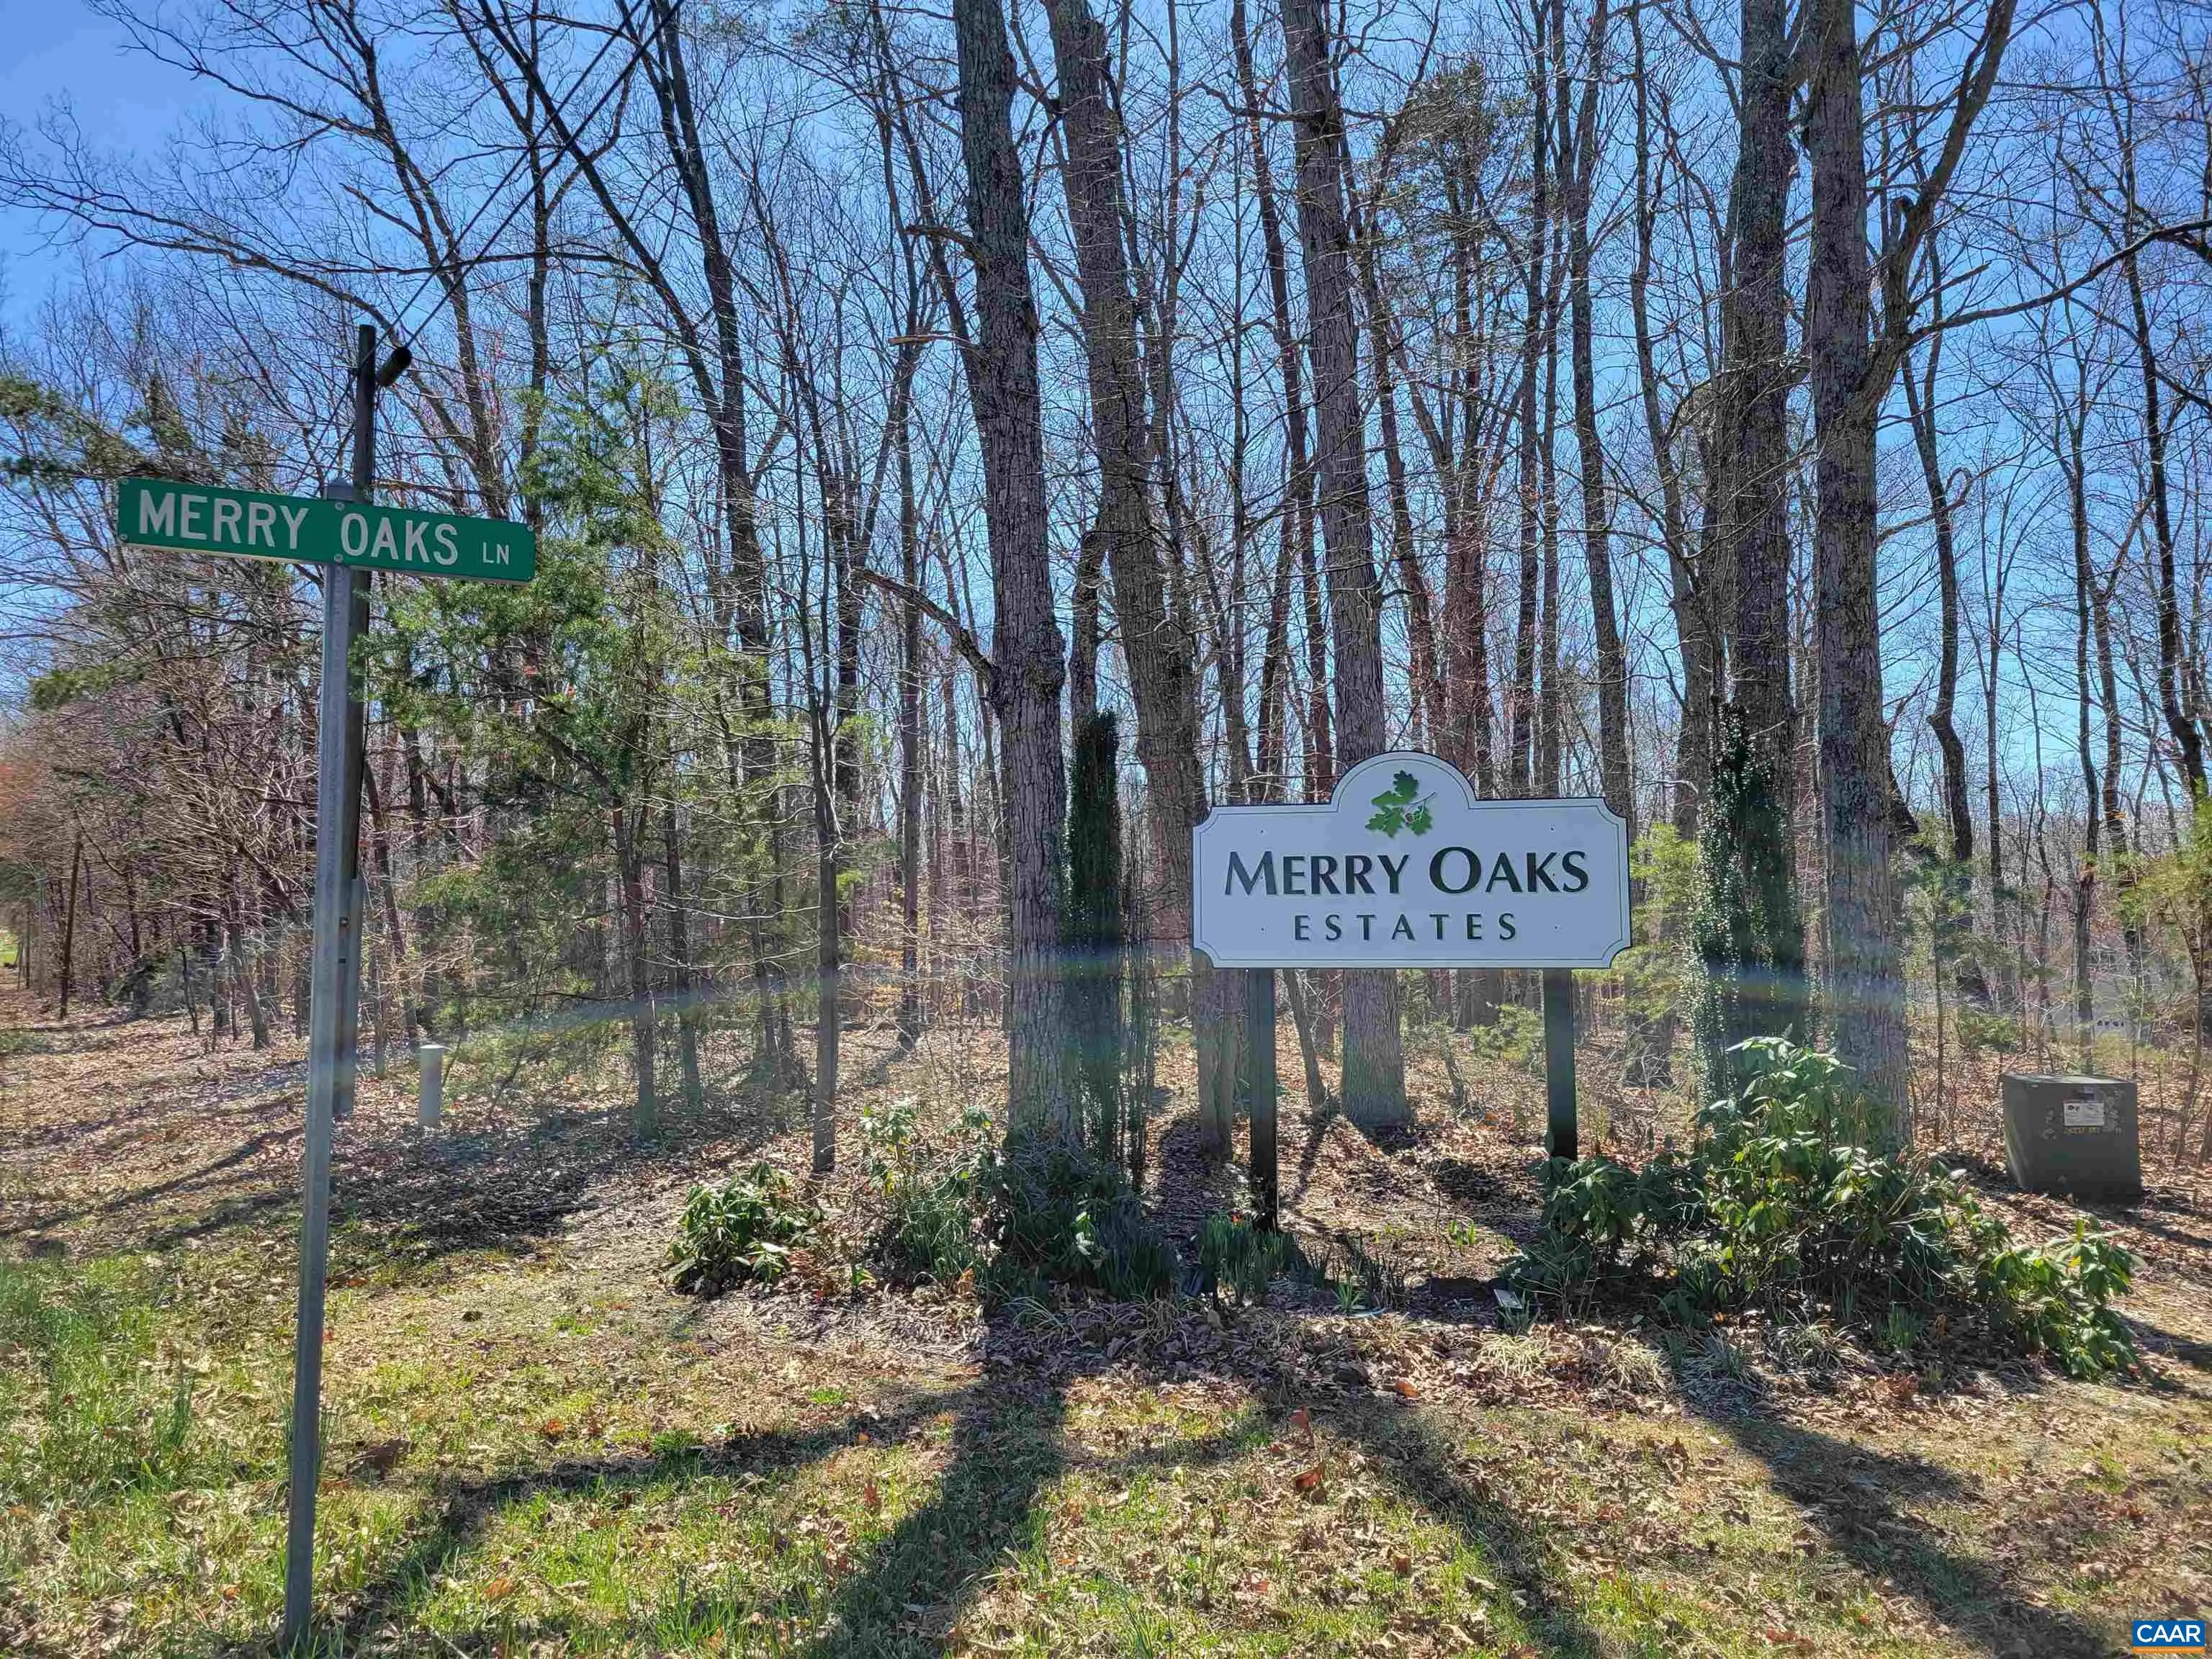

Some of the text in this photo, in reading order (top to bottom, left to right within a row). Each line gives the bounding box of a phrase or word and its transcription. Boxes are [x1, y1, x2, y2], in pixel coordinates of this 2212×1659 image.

[138, 488, 510, 566] MERRY OAKS LN
[1224, 846, 1589, 895] MERRY OAKS
[1294, 913, 1516, 942] ESTATES
